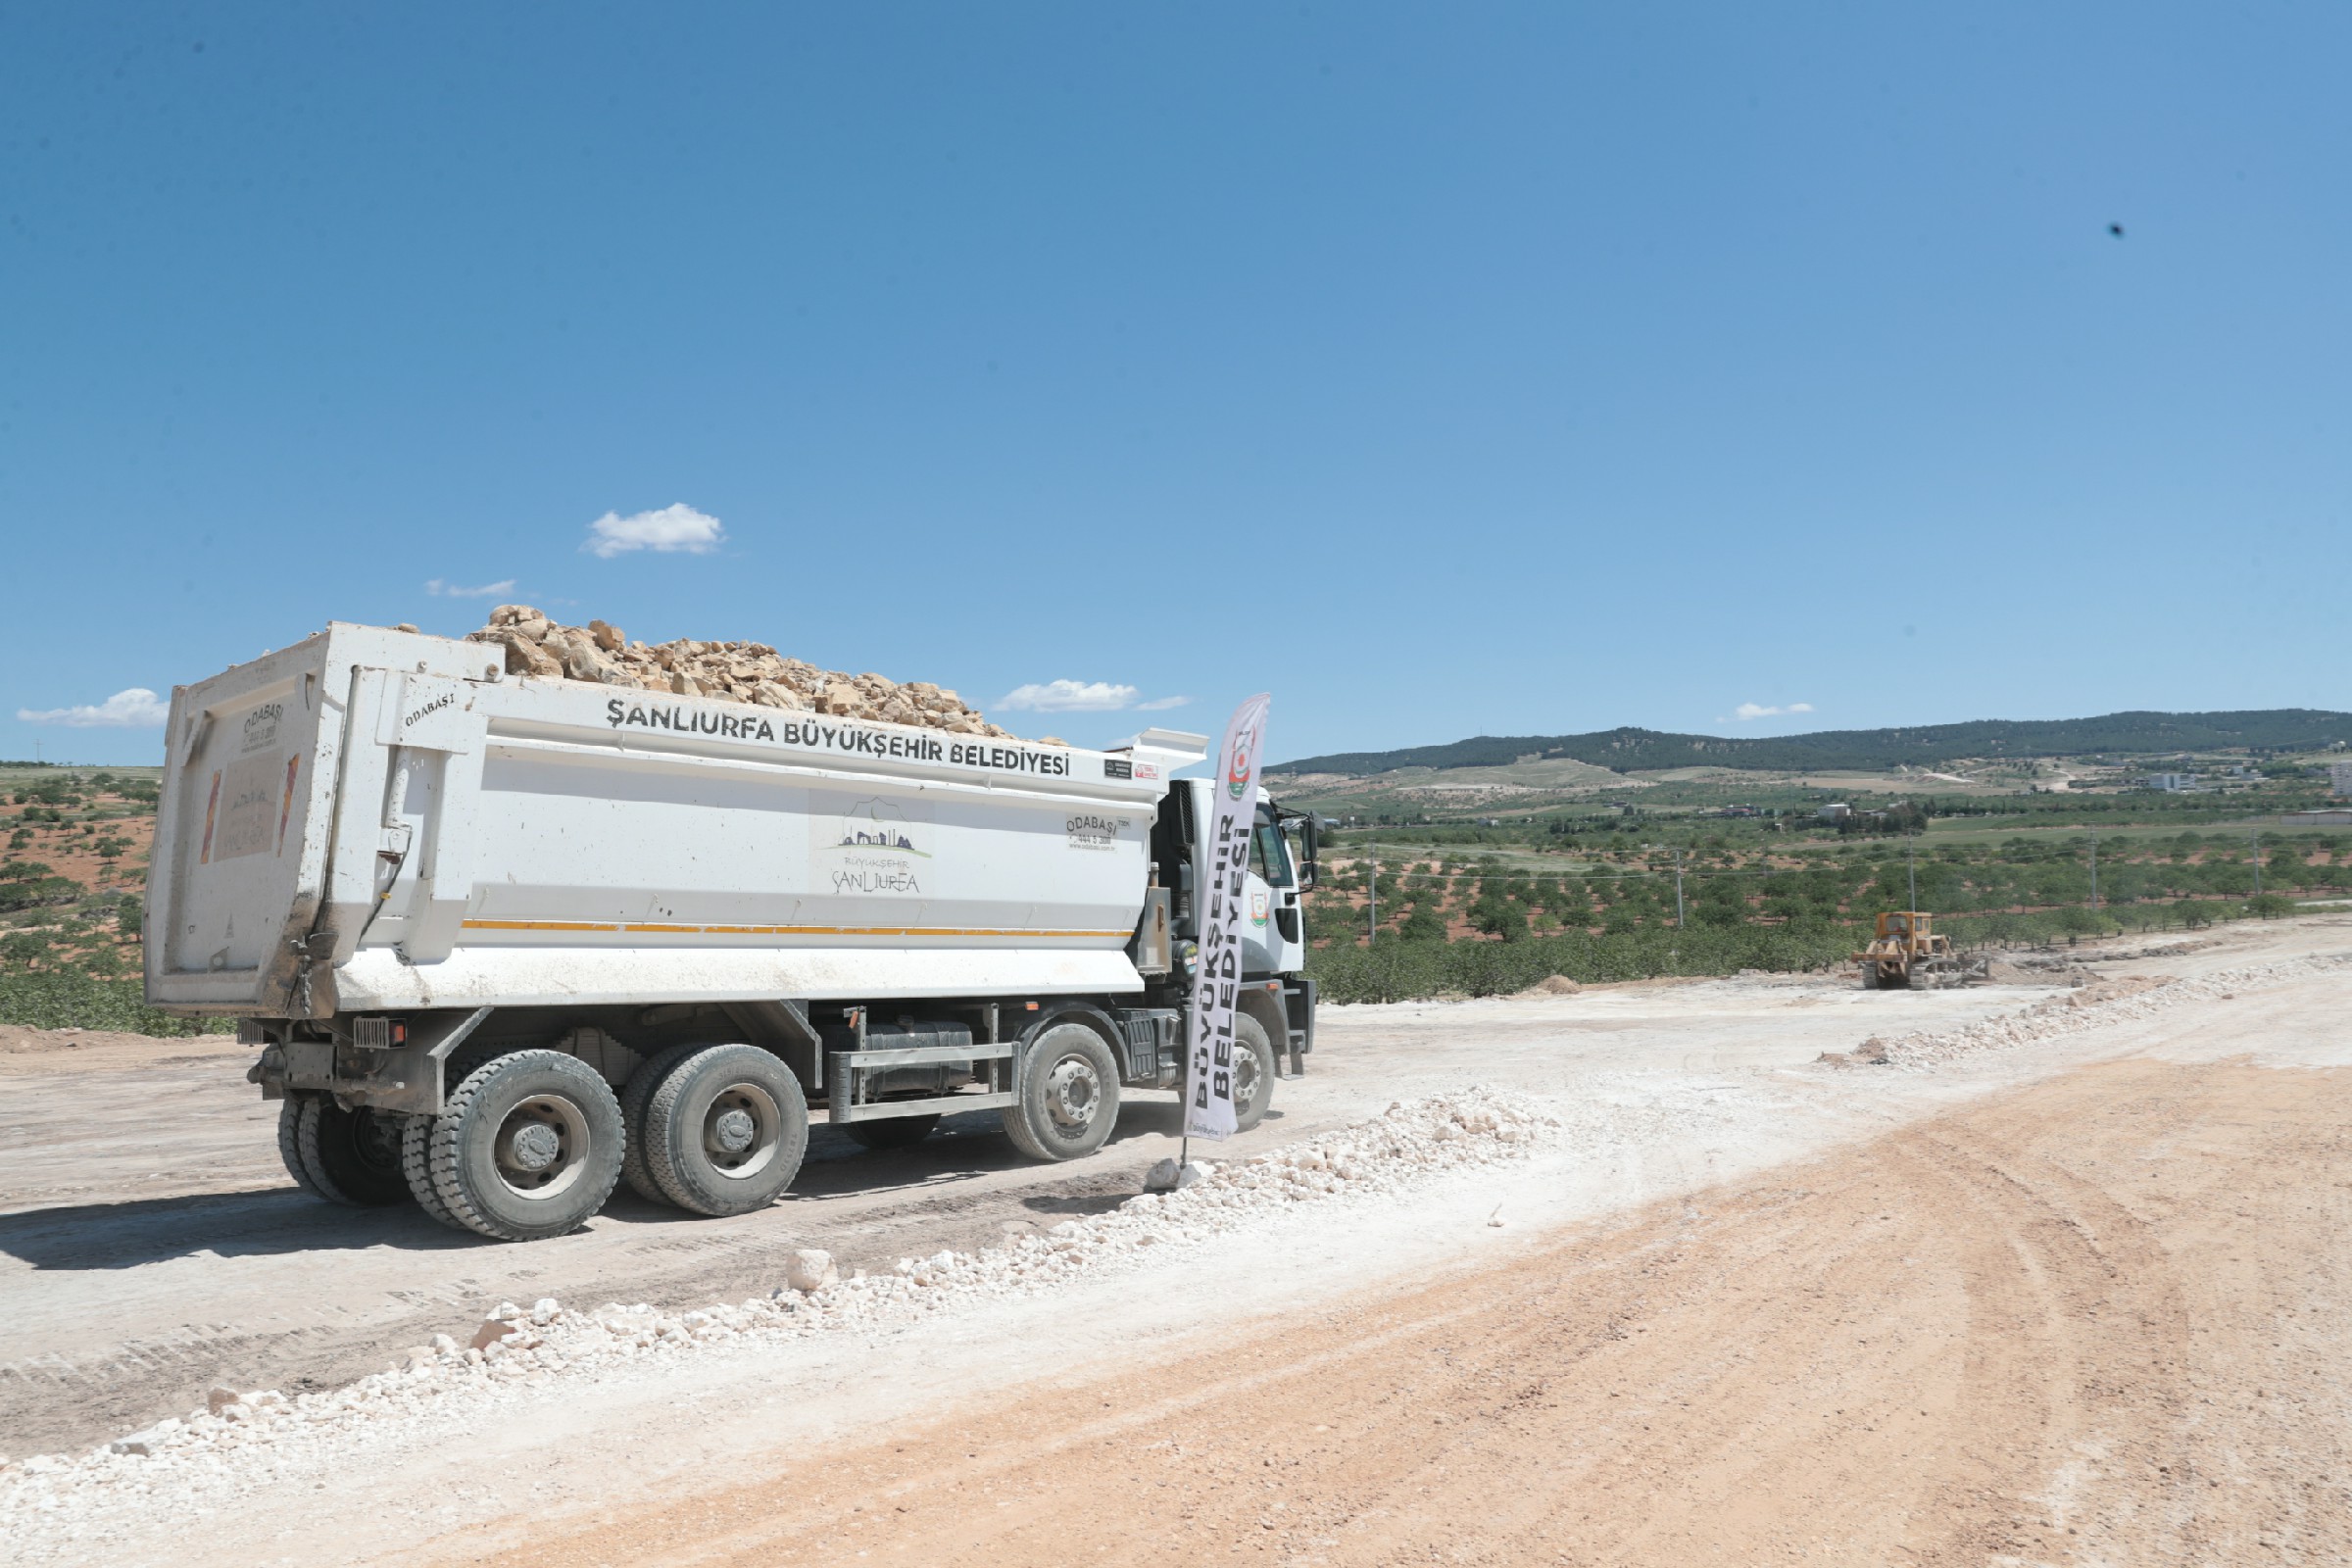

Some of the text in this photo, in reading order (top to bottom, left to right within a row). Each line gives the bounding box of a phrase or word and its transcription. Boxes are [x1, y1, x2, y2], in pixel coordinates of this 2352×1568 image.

[406, 693, 455, 727] ODABAŞI
[607, 699, 1070, 776] ŞANLIURFA BÜYÜKŞEHİR BELEDİYESİ
[844, 856, 909, 870] BÜYÜKŞEHİR
[831, 870, 920, 895] ŞANLIURFA
[1194, 814, 1250, 1109] BÜYÜKŞEHİR BELEDİYESİ
